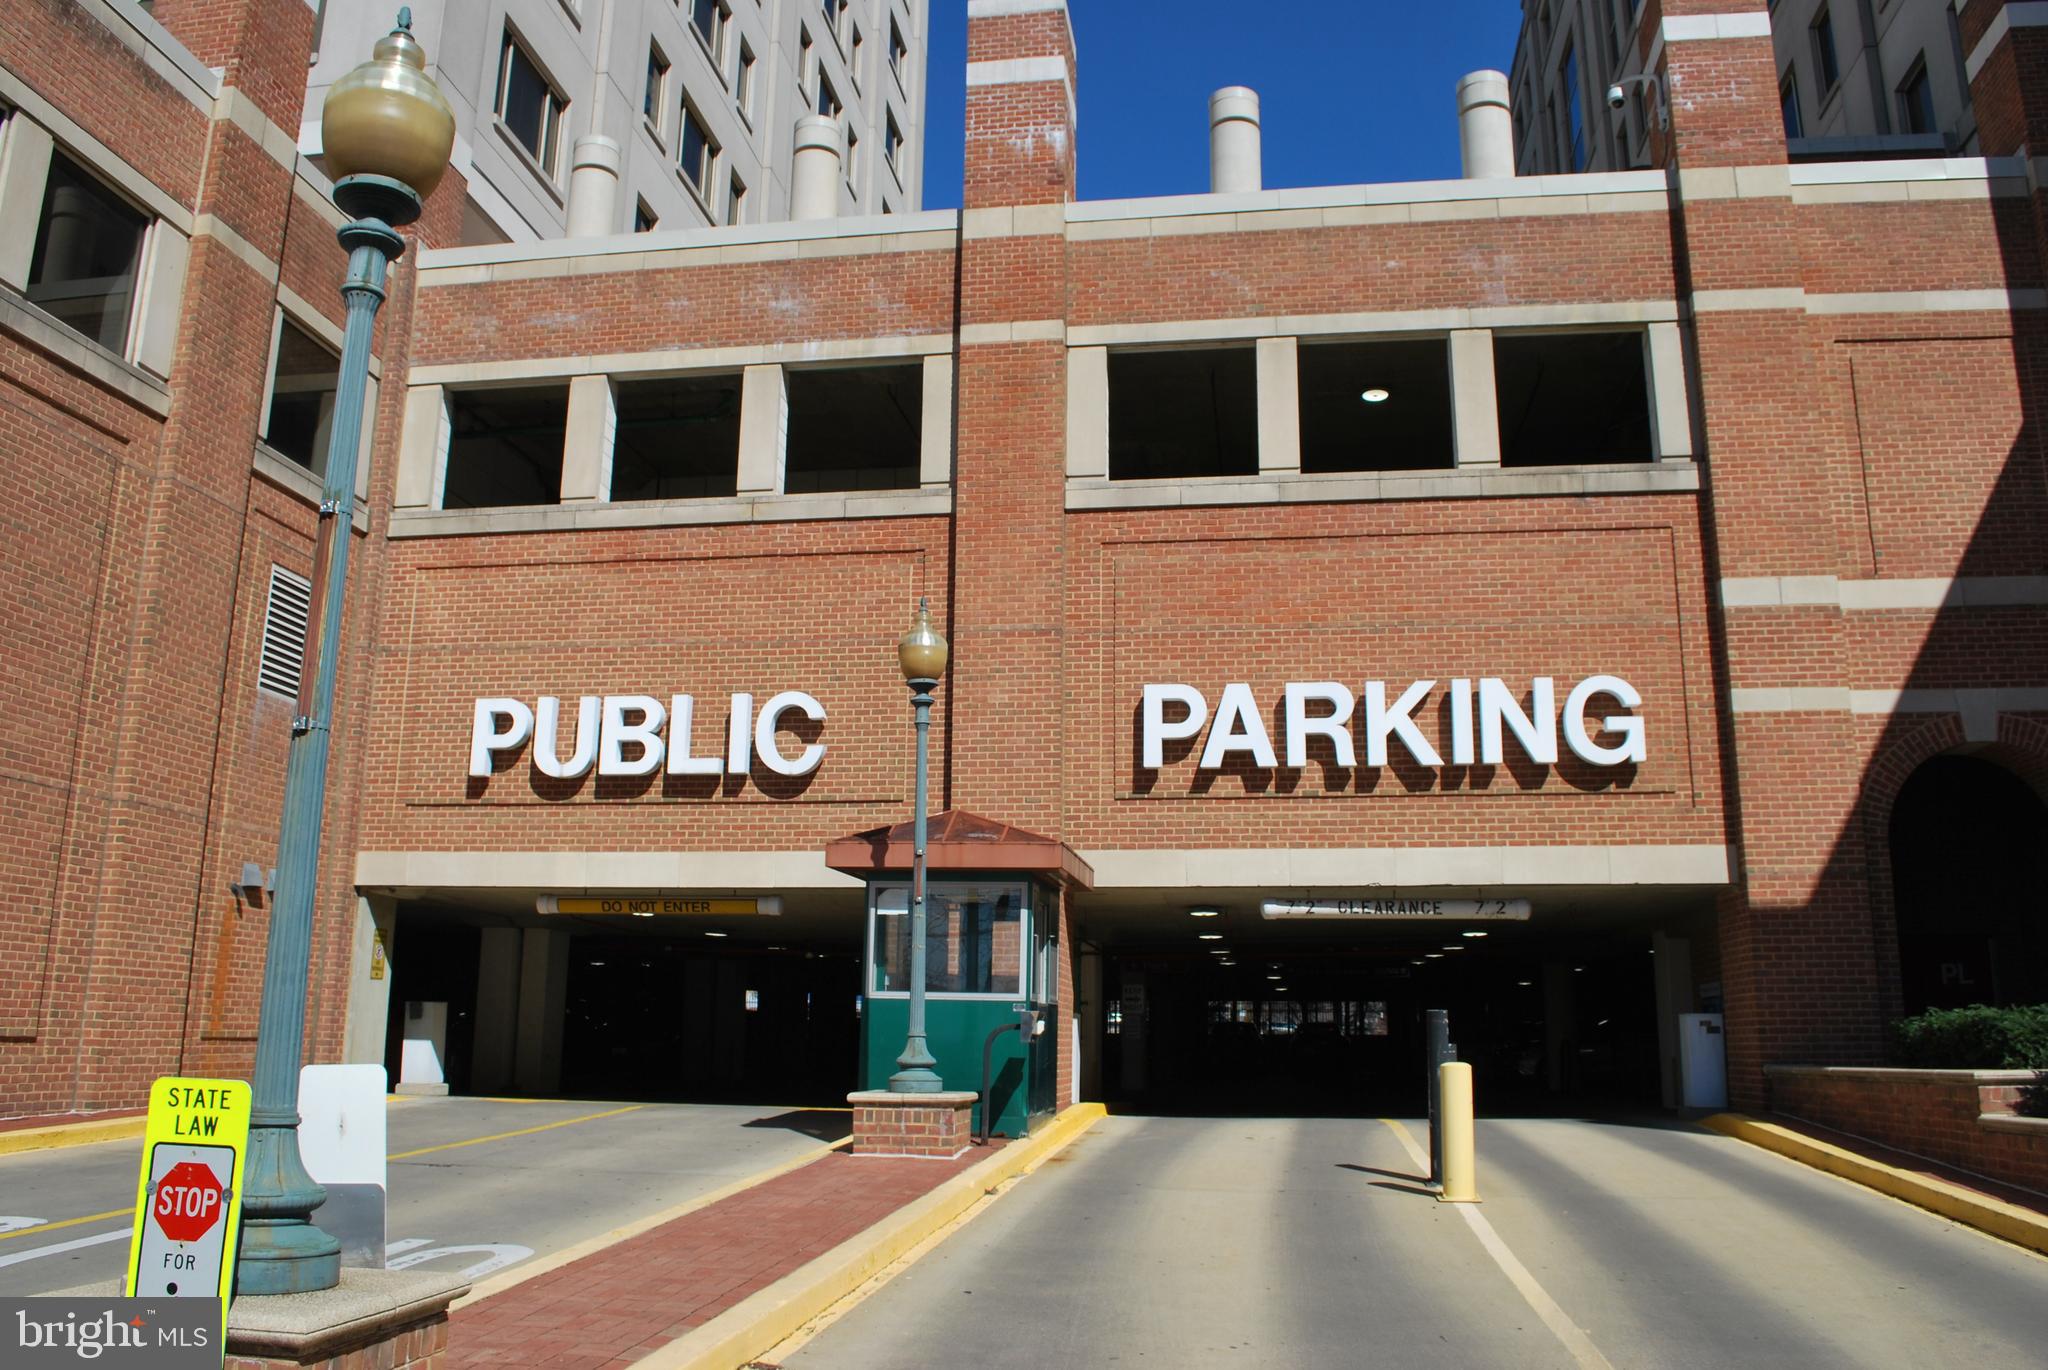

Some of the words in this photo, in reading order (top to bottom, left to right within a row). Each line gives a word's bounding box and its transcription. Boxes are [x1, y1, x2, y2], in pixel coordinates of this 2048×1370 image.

[469, 691, 827, 778] PUBLIC
[1143, 674, 1647, 769] PARKING
[601, 901, 622, 913] DO
[628, 901, 657, 913] NOT
[663, 901, 711, 913] ENTER
[1338, 900, 1443, 915] CLEARANCE
[168, 1087, 232, 1110] STATE
[175, 1114, 219, 1137] LAW
[158, 1185, 218, 1218] STOP
[163, 1253, 196, 1271] FOR
